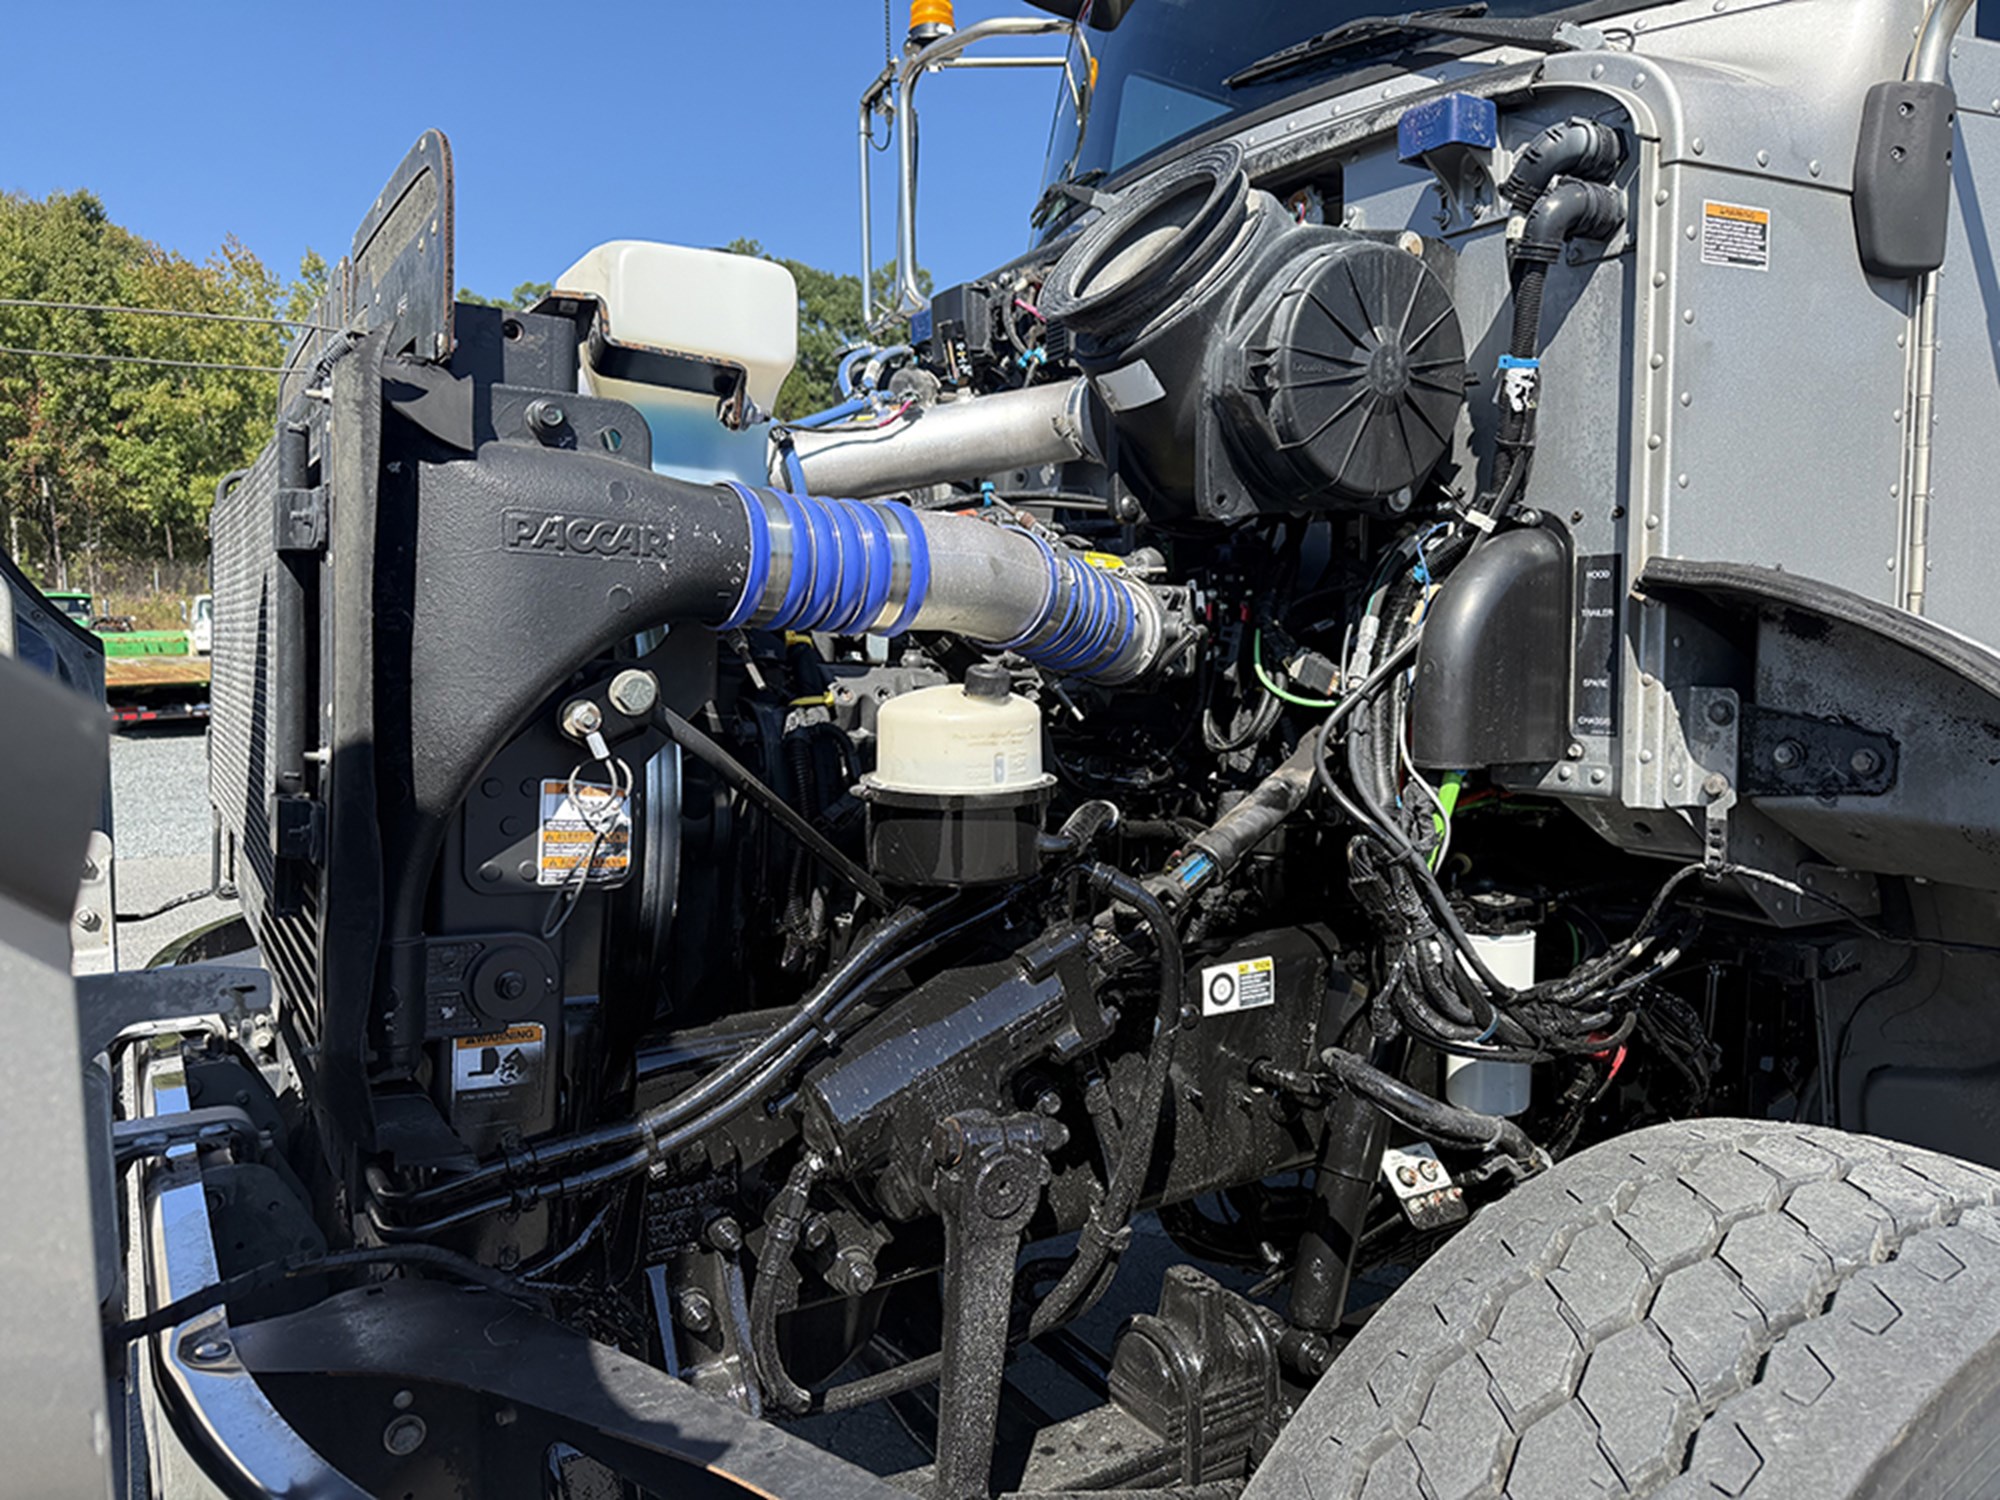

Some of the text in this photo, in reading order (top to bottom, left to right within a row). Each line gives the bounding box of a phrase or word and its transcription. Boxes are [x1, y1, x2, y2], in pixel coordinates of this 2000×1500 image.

[508, 515, 668, 557] PACCAR
[1586, 570, 1610, 579] HOOD
[1582, 608, 1614, 617] TRAILER
